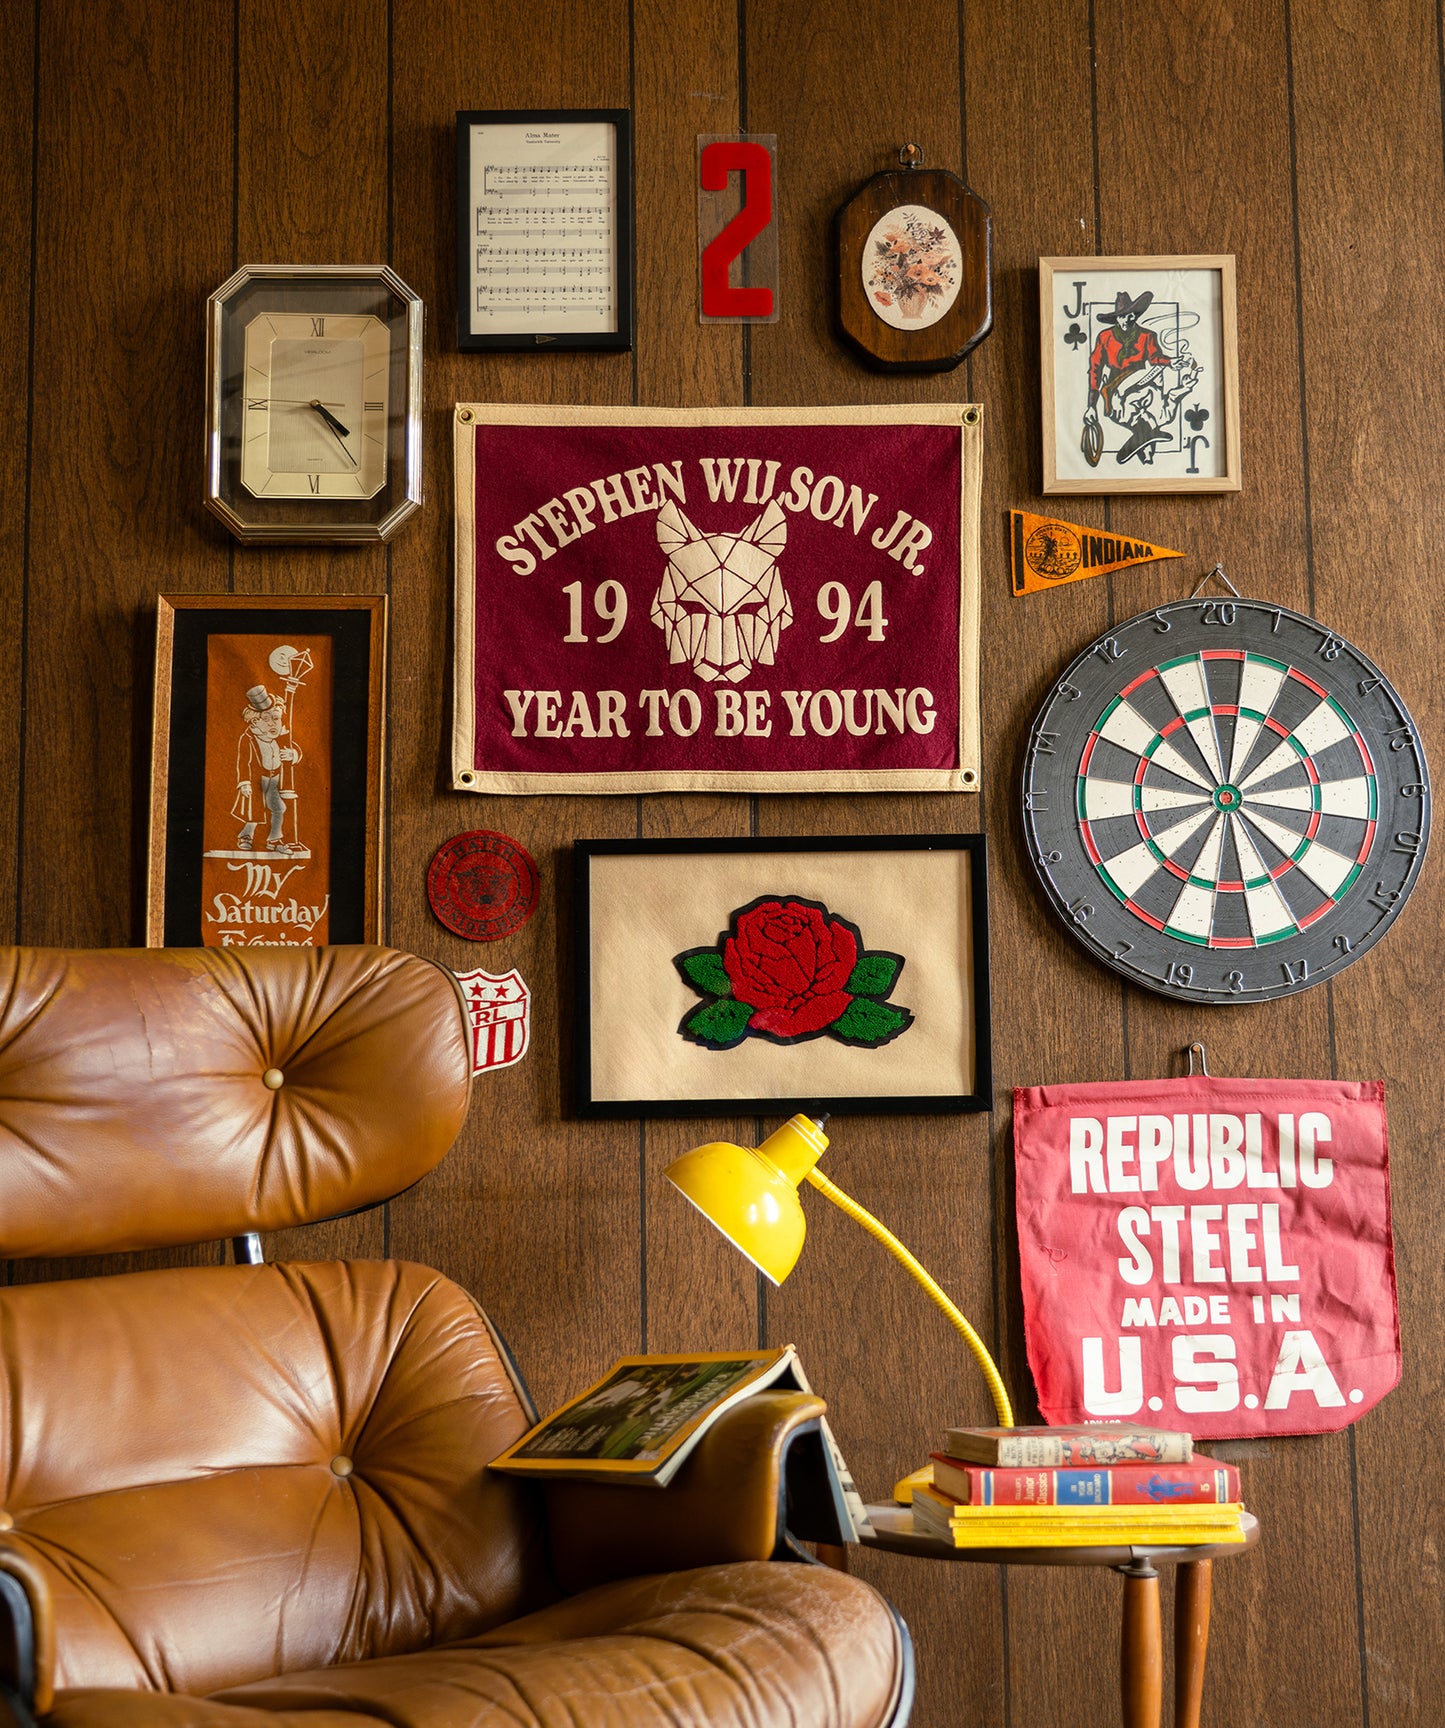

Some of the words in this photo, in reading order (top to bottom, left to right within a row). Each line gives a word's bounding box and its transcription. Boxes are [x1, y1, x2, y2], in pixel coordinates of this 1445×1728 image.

[701, 142, 773, 317] 2
[310, 317, 325, 337] XII
[495, 459, 687, 576] STEPHEN
[699, 457, 879, 536] WILSON
[872, 509, 934, 577] JR.
[1082, 535, 1153, 568] INDIANA
[562, 579, 628, 643] 19
[816, 579, 889, 643] 94
[1155, 607, 1171, 633] 5
[1202, 600, 1236, 626] 20
[1092, 636, 1129, 663] 12
[1318, 631, 1345, 661] 18
[1058, 681, 1081, 700] 9
[1361, 678, 1383, 697] 4
[503, 689, 631, 738] YEAR
[639, 688, 702, 738] TO
[714, 688, 771, 738] BE
[781, 687, 938, 737] YOUNG
[1032, 730, 1061, 754] 14
[1386, 722, 1416, 751] 13
[1401, 783, 1427, 797] 6
[452, 839, 514, 859] HATCH
[1392, 830, 1423, 856] 10
[1039, 850, 1062, 867] 8
[227, 861, 306, 900] My
[1063, 896, 1095, 924] 16
[1369, 880, 1401, 914] 15
[205, 892, 330, 932] Saturday
[1114, 939, 1135, 959] 7
[1334, 934, 1353, 953] 2
[1163, 961, 1193, 987] 19
[1229, 970, 1244, 995] 3
[1281, 959, 1308, 984] 17
[471, 1008, 507, 1026] RL
[1069, 1112, 1334, 1194] REPUBLIC
[1117, 1203, 1300, 1285] STEEL
[1121, 1295, 1231, 1327] MADE
[1252, 1293, 1301, 1324] IN
[1082, 1329, 1364, 1416] U.S.A.
[1023, 1476, 1035, 1501] Junior
[1036, 1472, 1048, 1505] Classics
[1200, 1483, 1210, 1493] 5
